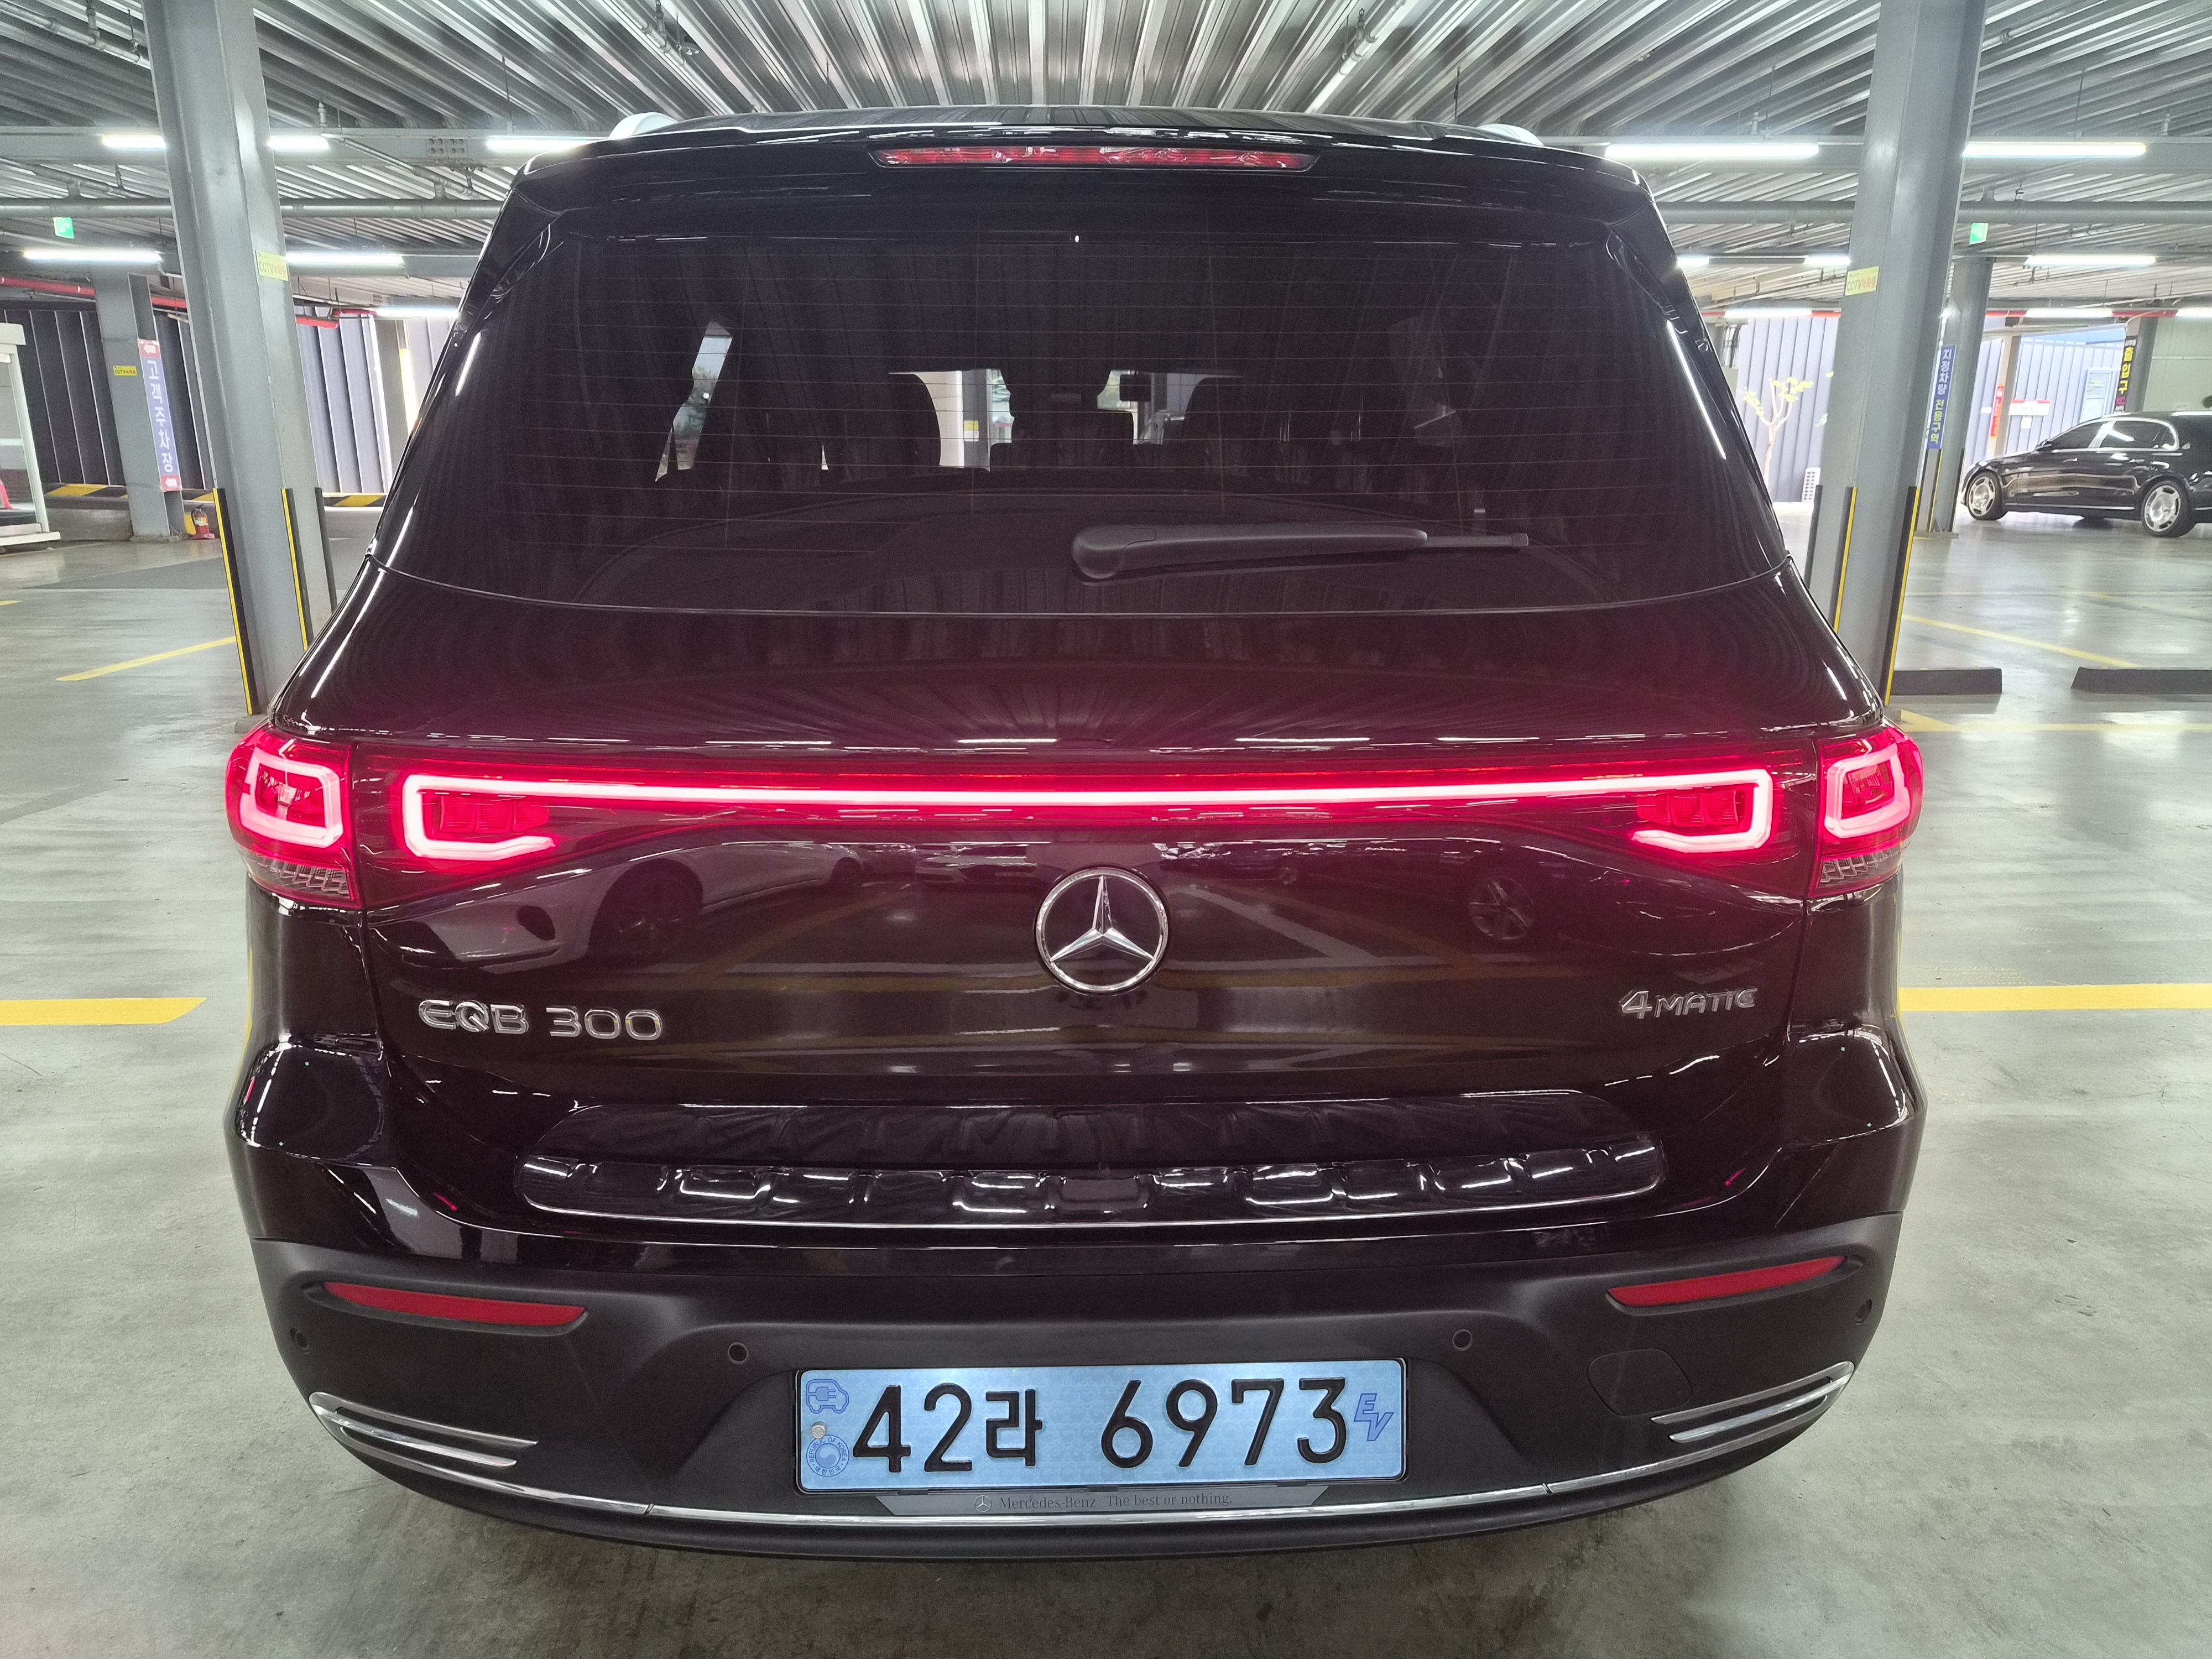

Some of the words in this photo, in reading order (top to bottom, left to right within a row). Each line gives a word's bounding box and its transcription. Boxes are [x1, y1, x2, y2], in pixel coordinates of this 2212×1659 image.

[147, 360, 173, 473] 고객주차장
[419, 999, 529, 1034] EQB
[546, 1005, 663, 1041] 300
[1620, 988, 1758, 1019] 4MATIC
[853, 1383, 1043, 1473] 42라
[1101, 1377, 1347, 1469] 6973
[1354, 1393, 1395, 1442] EV
[837, 1441, 847, 1462] KOREA
[815, 1465, 842, 1475] 대한민국
[999, 1496, 1096, 1510] Mercedes-Benz
[1107, 1495, 1129, 1507] The
[1134, 1495, 1159, 1506] best
[1164, 1496, 1177, 1505] or
[1181, 1493, 1232, 1506] nothing.
